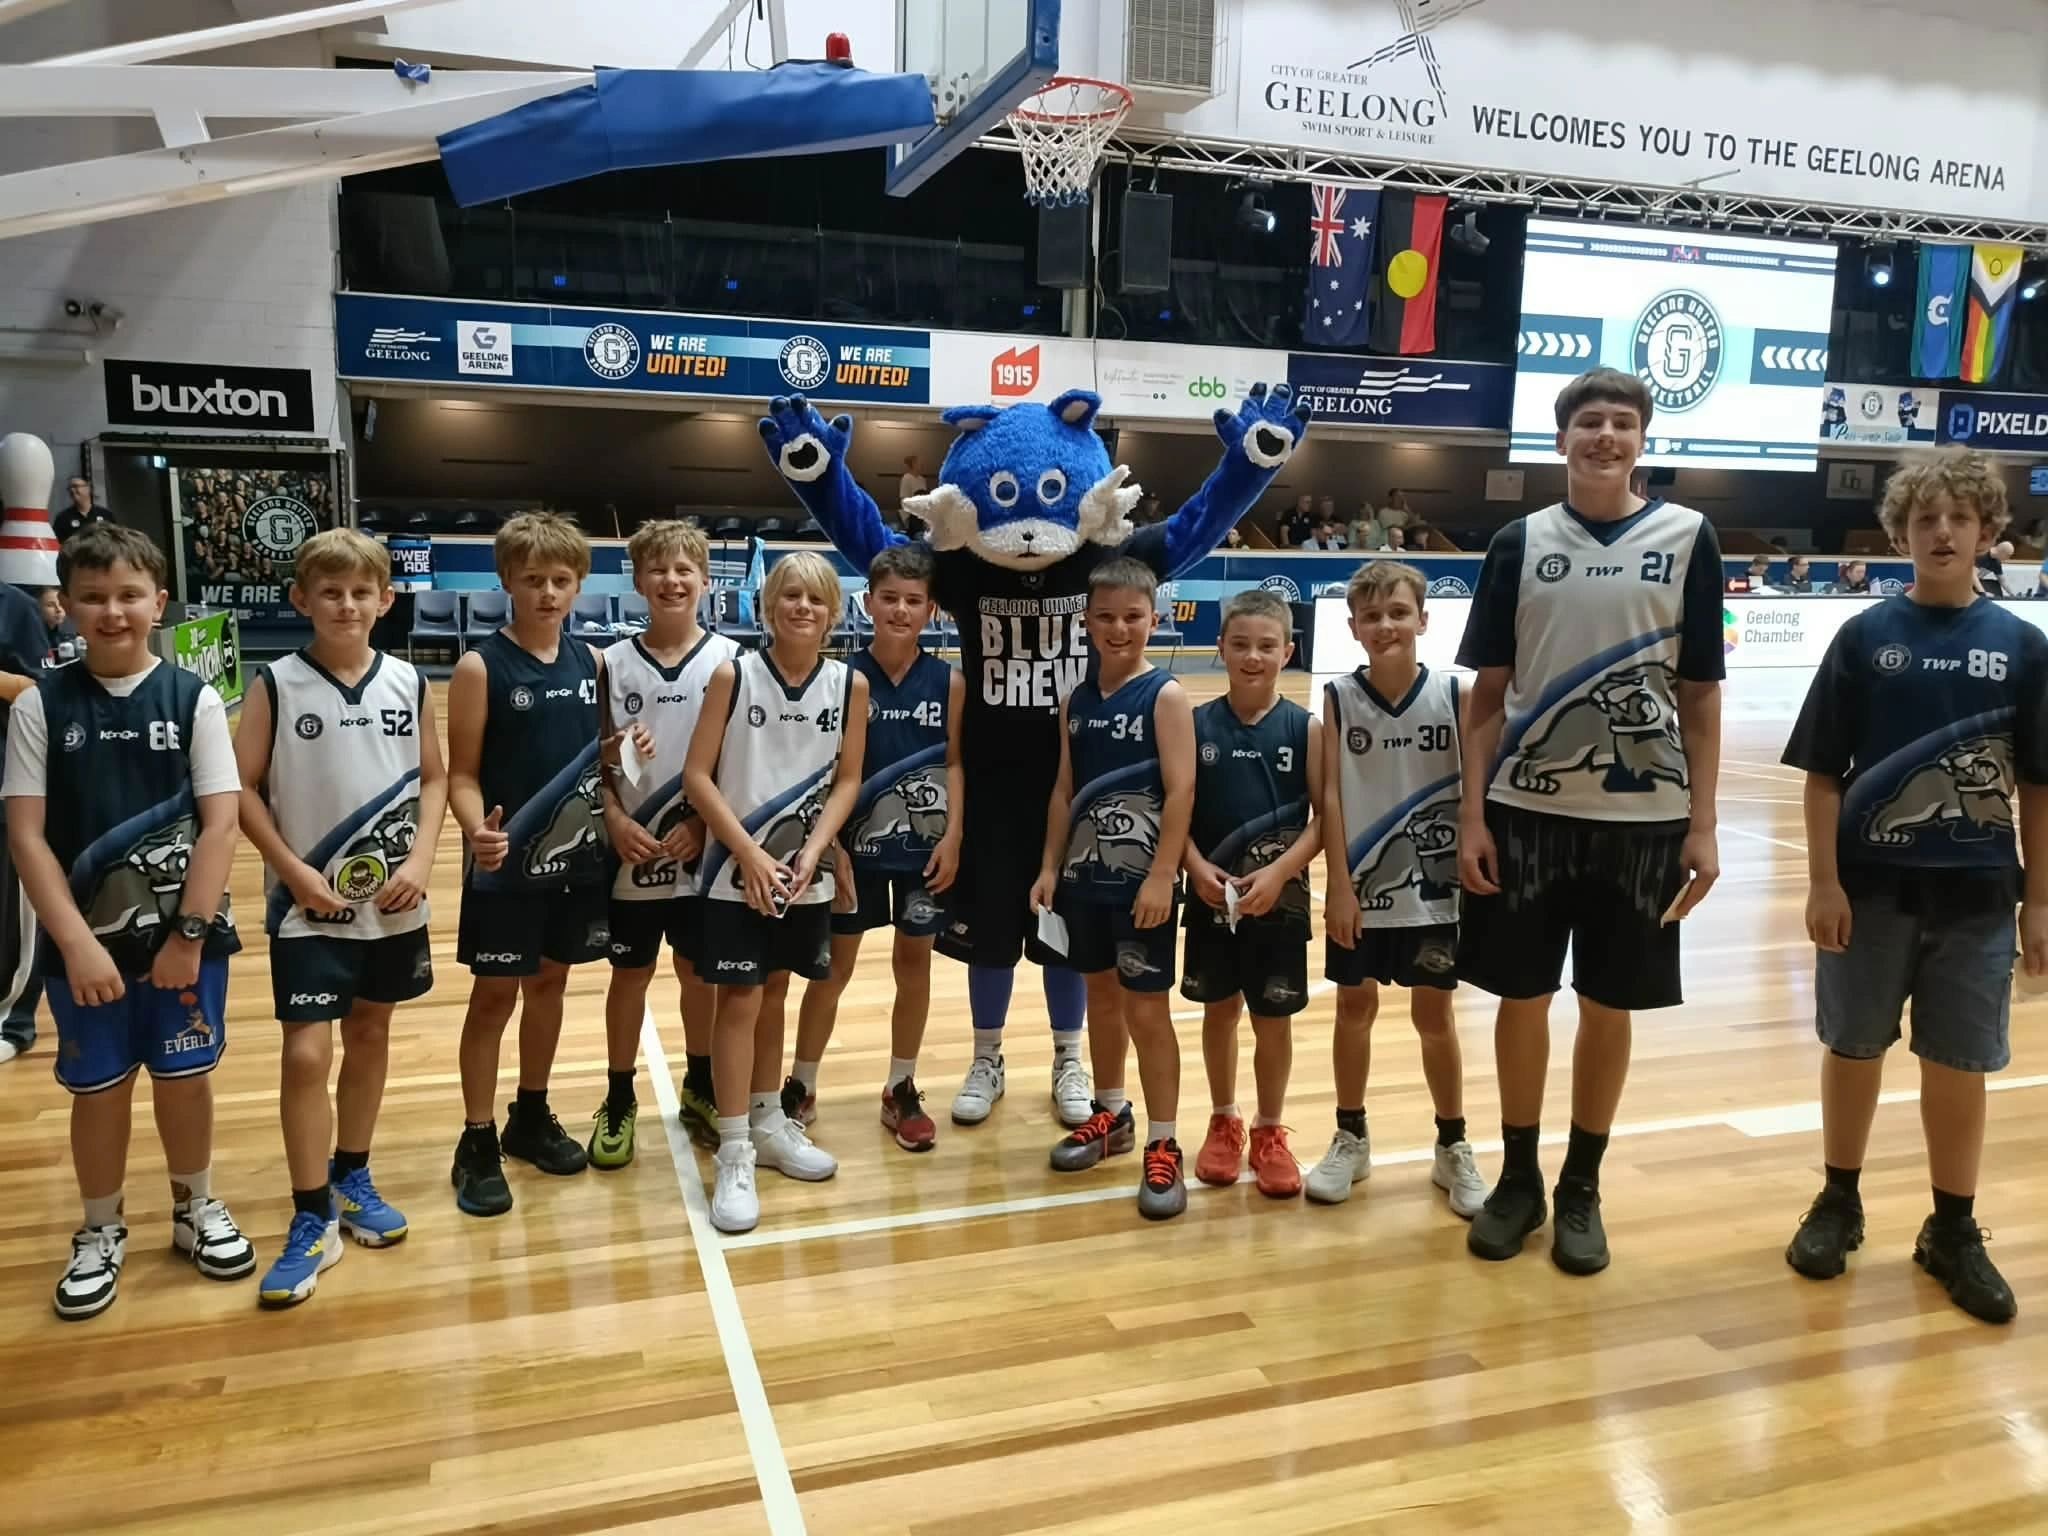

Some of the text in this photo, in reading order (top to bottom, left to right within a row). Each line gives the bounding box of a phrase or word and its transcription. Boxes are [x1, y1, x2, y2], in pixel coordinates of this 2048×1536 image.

[1271, 64, 1368, 86] CITY OF GREATER
[1265, 81, 1436, 127] GEELONG
[1302, 121, 1436, 145] SWIM SPORT & LEISURE
[1473, 105, 2005, 191] WELCOMES YOU TO THE GEELONG ARENA
[651, 334, 707, 352] WE ARE
[840, 345, 892, 363] WE ARE
[365, 348, 431, 361] GEELONG
[462, 351, 509, 362] GEELONG
[468, 360, 504, 370] ARENA
[647, 353, 727, 377] UNITED!
[836, 364, 909, 387] UNITED!
[996, 364, 1033, 386] 1915
[131, 374, 289, 417] buxton
[1188, 376, 1226, 398] cbb
[1297, 395, 1392, 414] GEELONG
[1976, 411, 2048, 435] PIXELD
[391, 550, 430, 562] OWER
[404, 561, 430, 573] ADE
[1585, 566, 1624, 577] TWP
[1640, 551, 1675, 584] 21
[201, 585, 280, 603] WE ARE
[1746, 610, 1800, 627] Geelong
[981, 612, 1088, 659] BLUE
[1744, 629, 1804, 643] Chamber
[1922, 658, 1962, 671] TWP
[1968, 648, 2009, 681] 86
[983, 657, 1088, 706] CREW
[381, 709, 413, 736] 52
[882, 709, 910, 720] TWP
[912, 701, 942, 727] 42
[1112, 713, 1143, 741] 34
[1418, 725, 1451, 751] 30
[1382, 737, 1412, 749] TWP
[1276, 746, 1293, 772] 3
